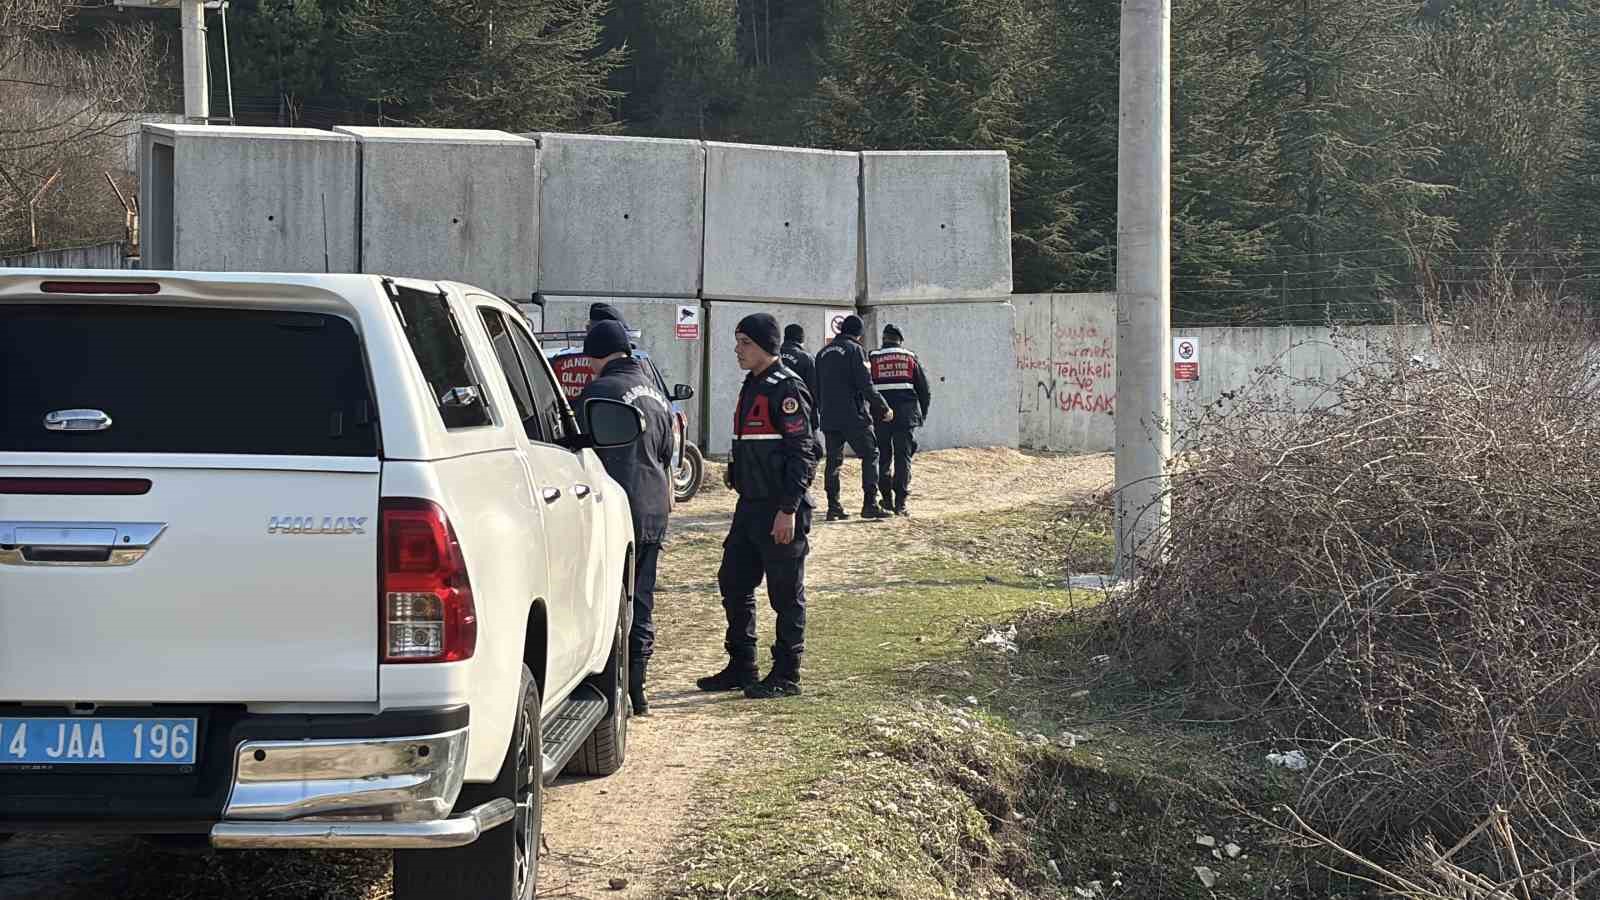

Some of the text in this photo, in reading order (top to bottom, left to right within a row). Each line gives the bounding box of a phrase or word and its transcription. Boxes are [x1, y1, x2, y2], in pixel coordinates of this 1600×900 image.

[561, 372, 588, 384] OLAY
[267, 514, 369, 535] HILUX
[45, 722, 106, 759] JAA
[132, 722, 190, 759] 196
